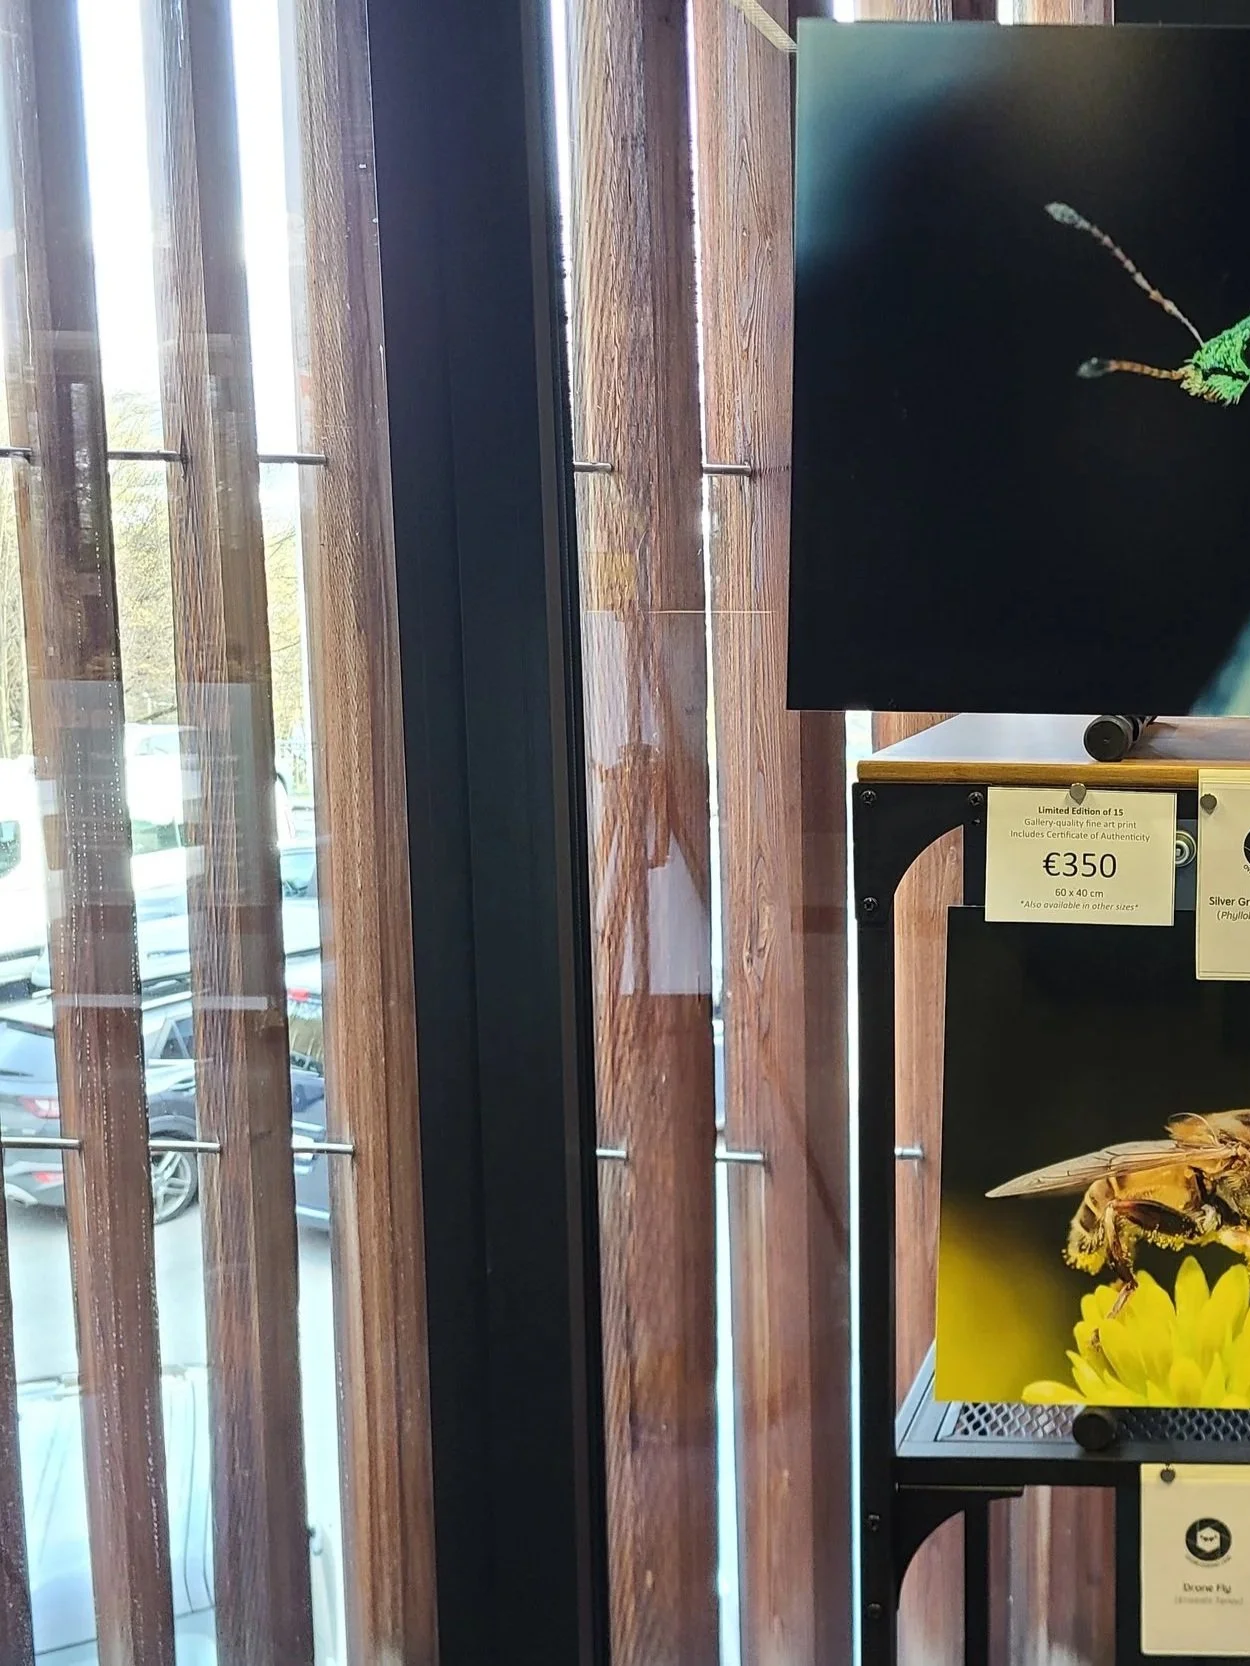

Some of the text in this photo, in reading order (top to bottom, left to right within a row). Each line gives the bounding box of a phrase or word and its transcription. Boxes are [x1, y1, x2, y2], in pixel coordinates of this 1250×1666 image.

[1038, 806, 1124, 816] Limited Edition of 15
[1024, 818, 1083, 829] Gallery-quality
[1086, 820, 1101, 828] fine
[1117, 821, 1137, 829] print
[1010, 830, 1044, 838] Includes
[1046, 831, 1089, 839] Certificate
[1101, 833, 1150, 842] Authenticity
[1043, 852, 1117, 878] €350
[1055, 888, 1066, 897] 60
[1076, 889, 1088, 897] 40
[1043, 901, 1080, 910] available
[1082, 902, 1089, 910] in
[1092, 902, 1114, 911] other
[1209, 897, 1235, 906] Silver
[1183, 1583, 1232, 1594] Drone Fly
